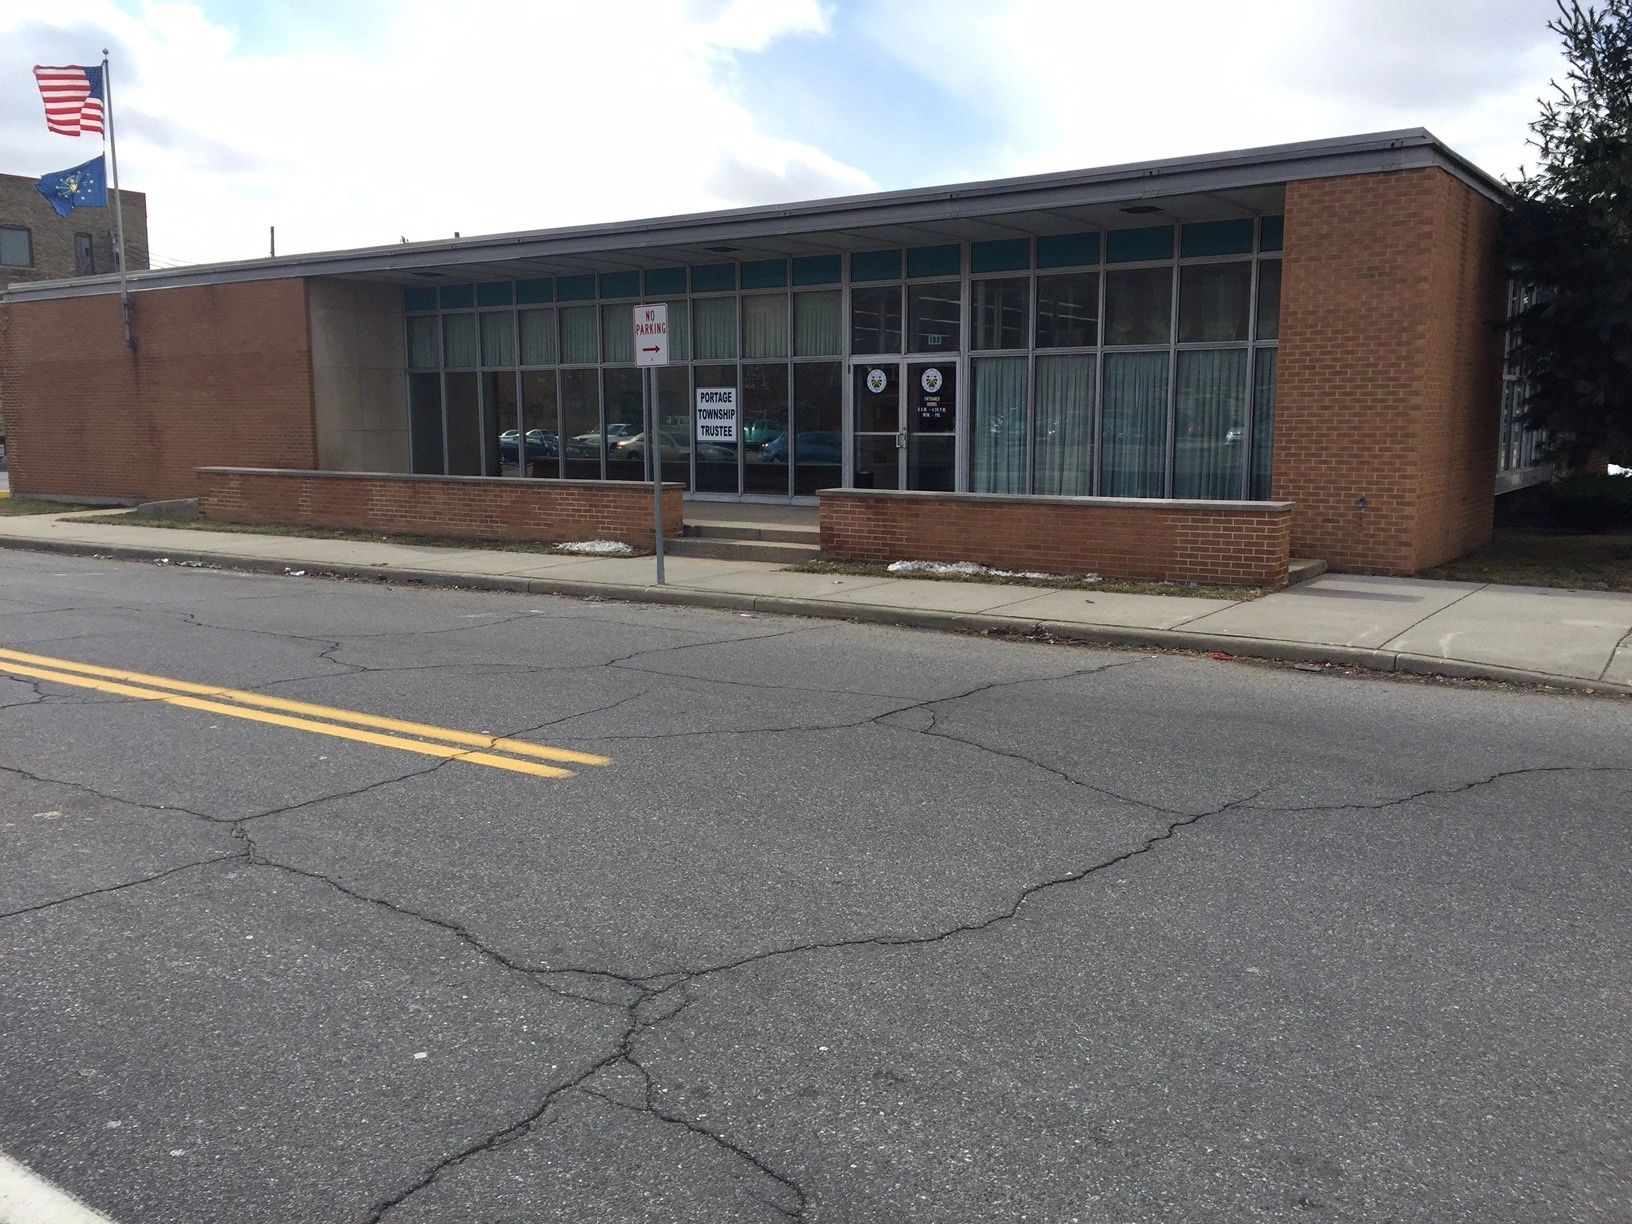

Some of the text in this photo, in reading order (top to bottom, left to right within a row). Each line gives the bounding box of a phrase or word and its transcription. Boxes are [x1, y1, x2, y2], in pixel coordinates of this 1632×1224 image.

[645, 310, 655, 321] NO
[636, 323, 666, 335] PARKING
[700, 391, 732, 403] PORTAGE
[698, 408, 736, 420] TOWNSHIP
[700, 425, 733, 437] TRUSTEE
